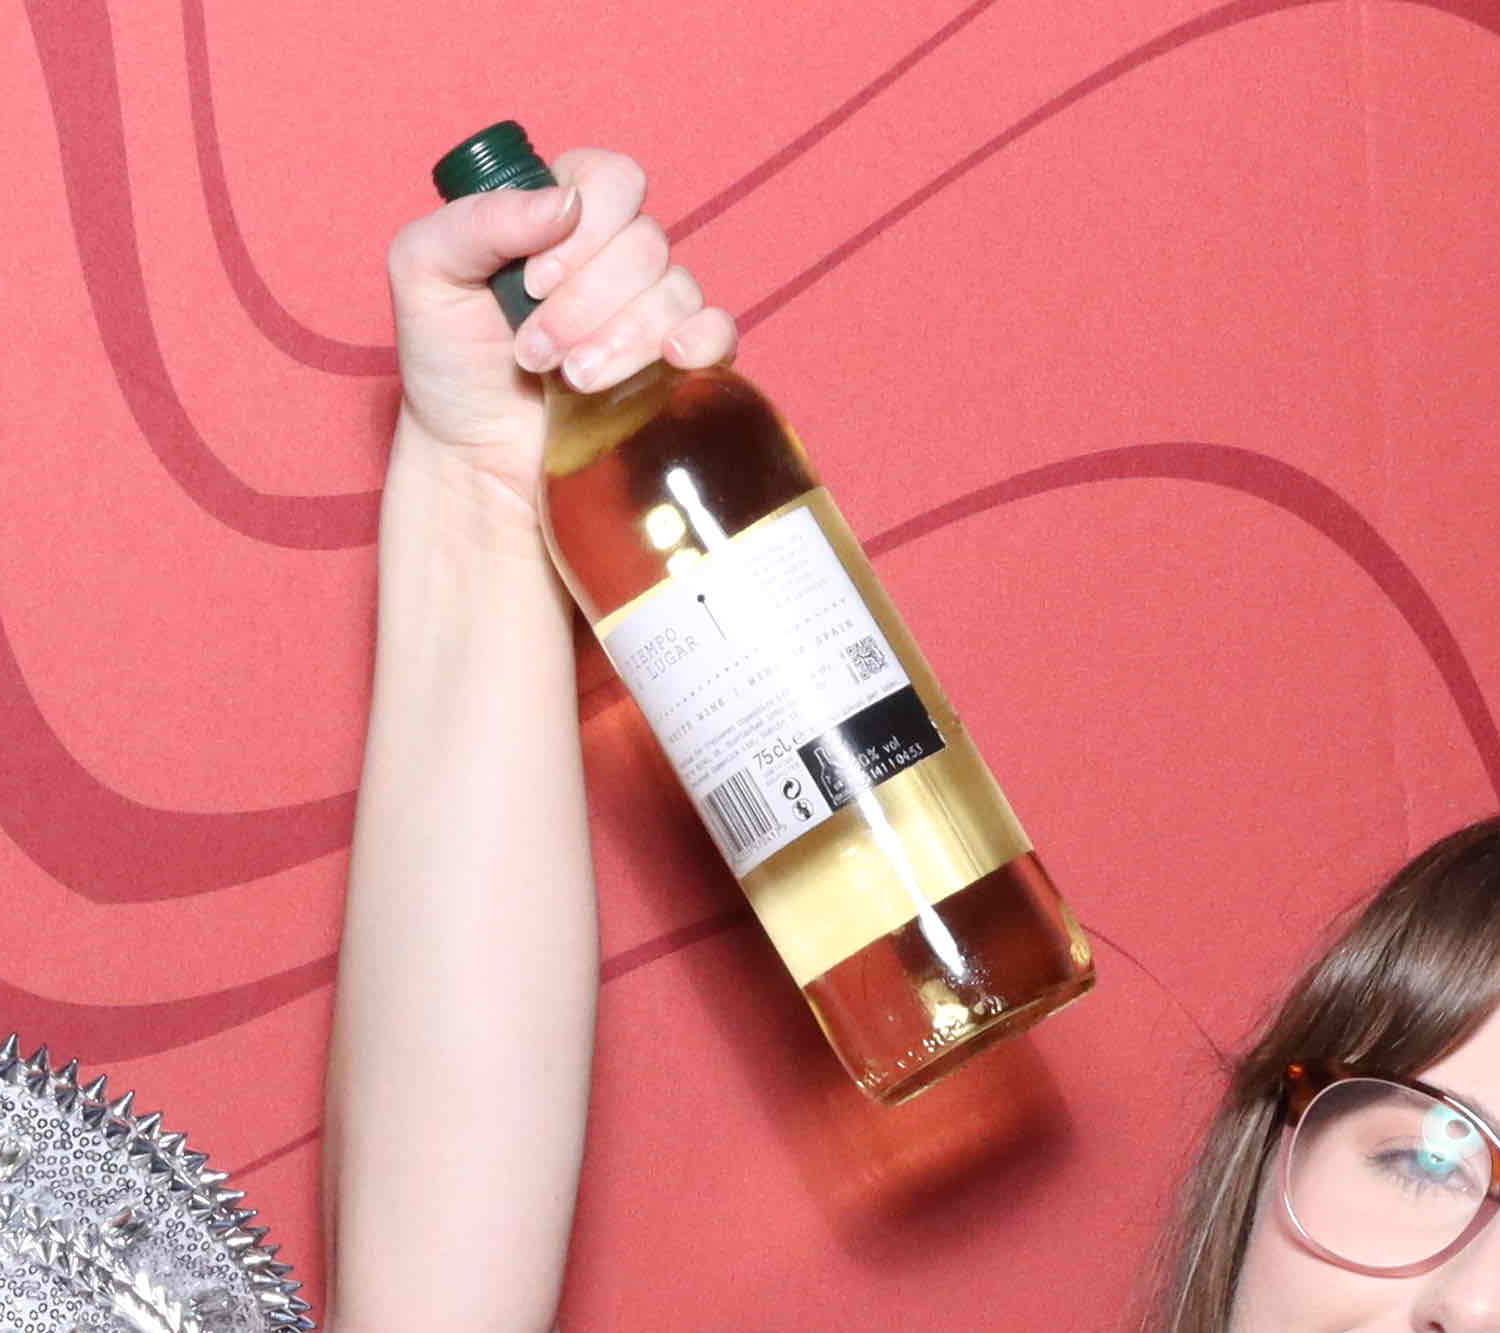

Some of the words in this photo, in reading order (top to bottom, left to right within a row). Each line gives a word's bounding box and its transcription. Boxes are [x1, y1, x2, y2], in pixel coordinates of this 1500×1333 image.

[646, 635, 699, 680] LUGAR
[752, 736, 792, 769] 75cl
[882, 735, 901, 753] vol
